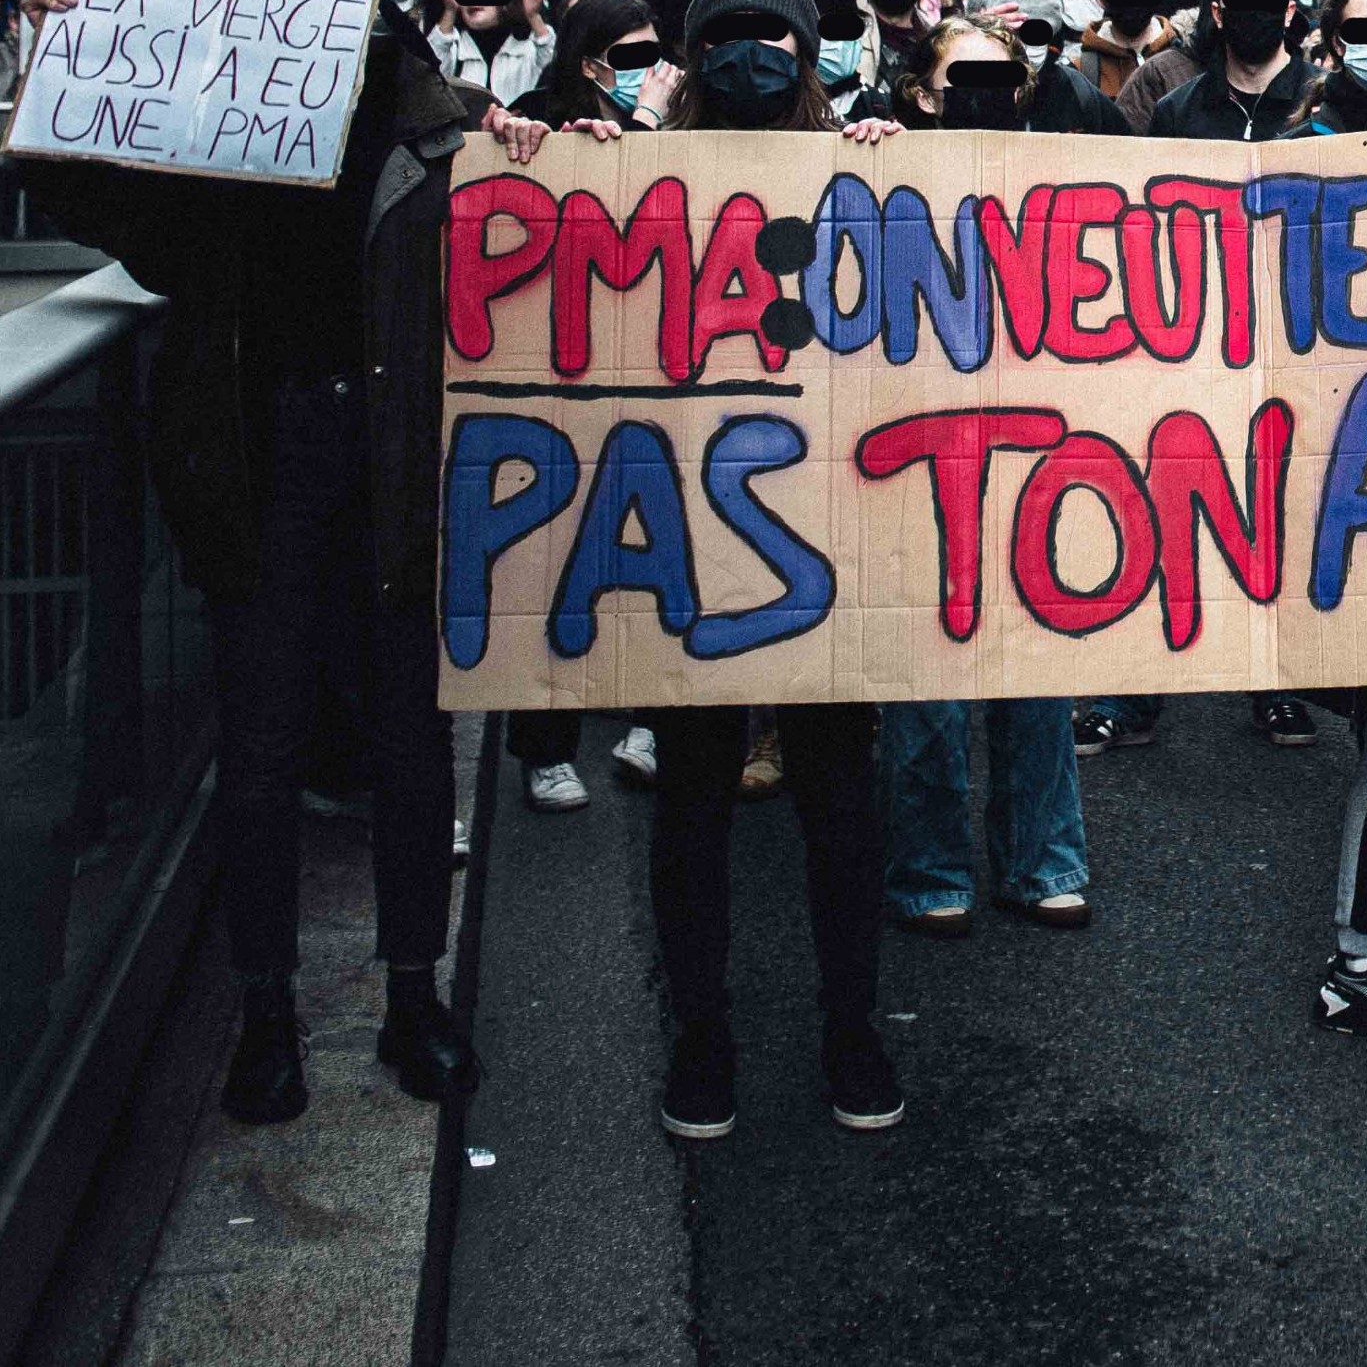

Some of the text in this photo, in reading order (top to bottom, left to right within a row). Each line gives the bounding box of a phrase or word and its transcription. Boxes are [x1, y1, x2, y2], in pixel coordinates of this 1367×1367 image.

[201, 46, 238, 101] A
[260, 57, 340, 110] EU
[207, 107, 316, 168] PMA
[801, 171, 996, 374] ON
[979, 174, 1256, 369] VEUT
[439, 411, 838, 672] PAS
[855, 397, 1298, 652] TON
